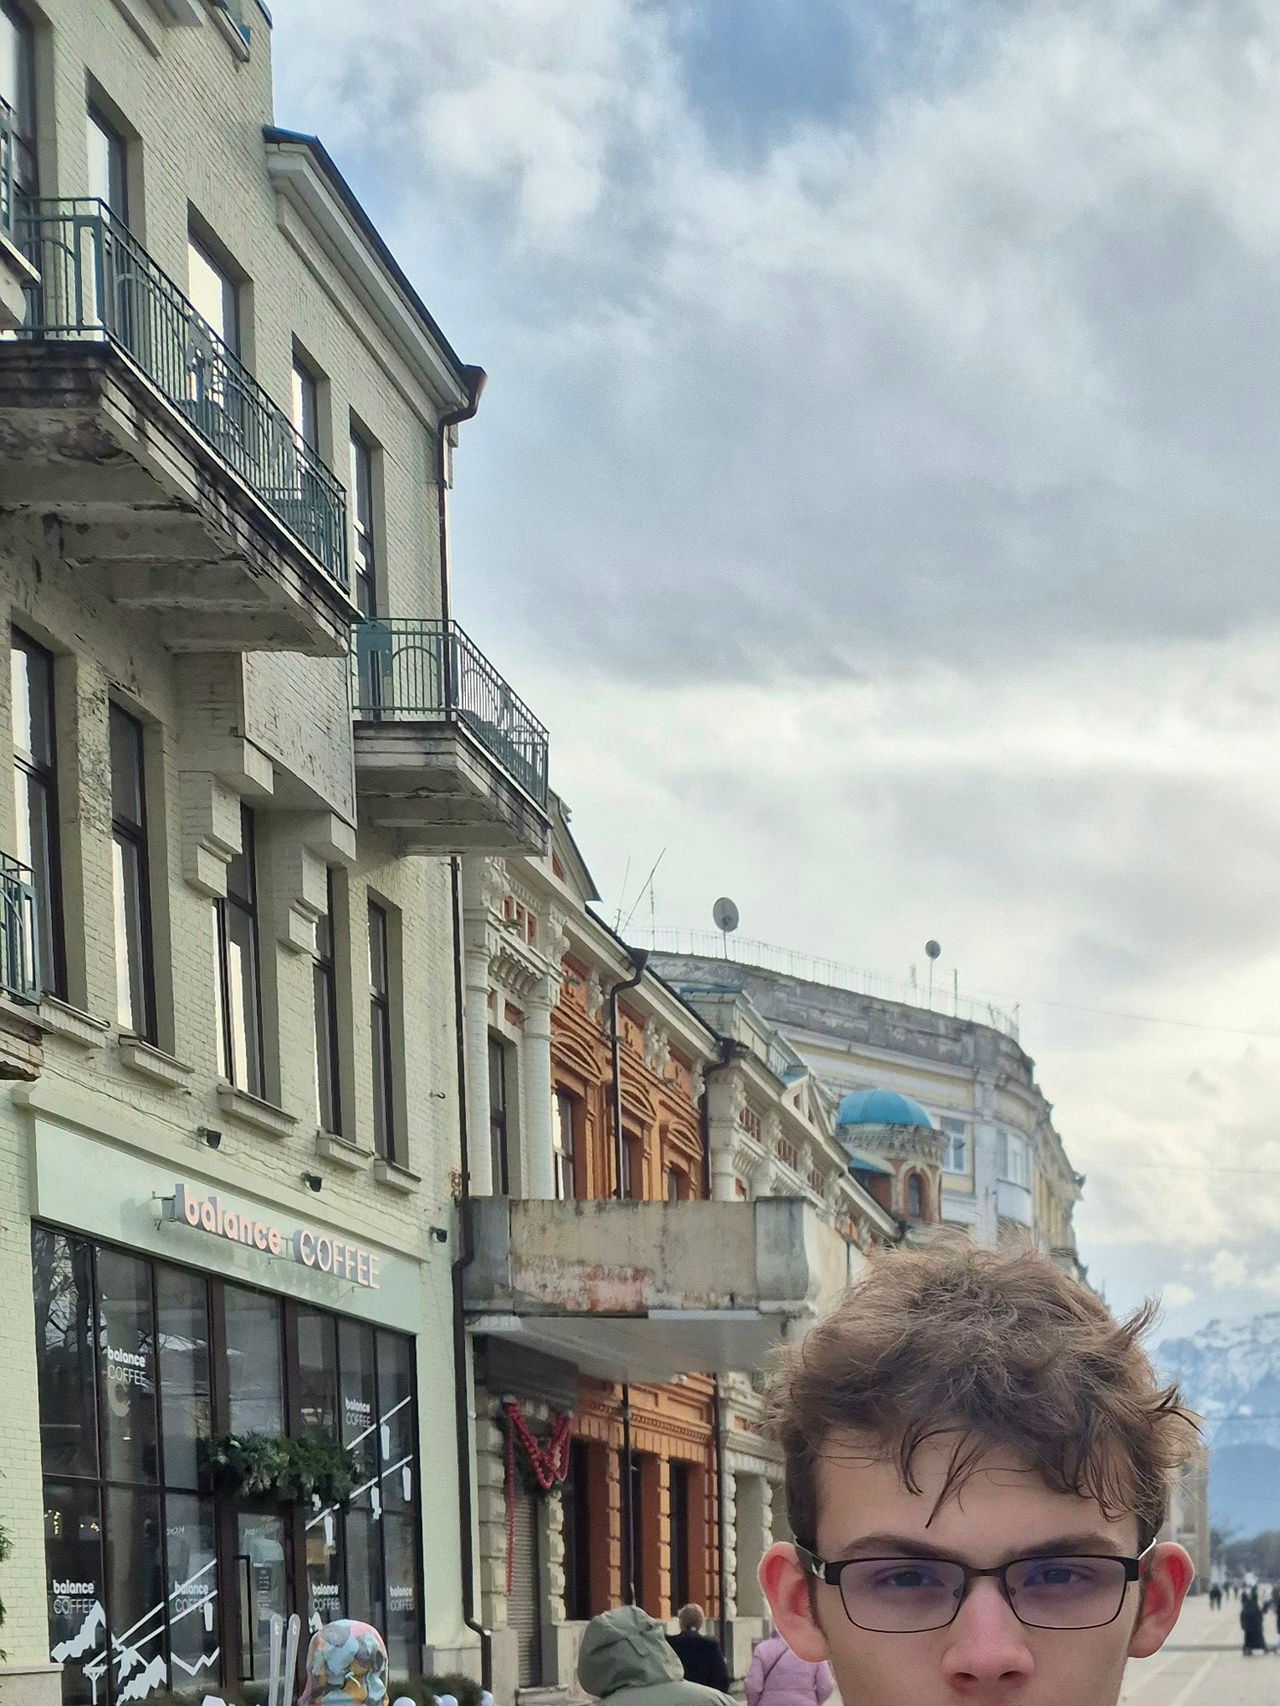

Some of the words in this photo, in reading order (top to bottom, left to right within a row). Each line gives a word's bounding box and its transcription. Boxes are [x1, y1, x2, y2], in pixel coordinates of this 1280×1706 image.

[176, 1183, 282, 1255] balance
[295, 1228, 381, 1289] COFFEE
[107, 1345, 146, 1367] balance
[107, 1365, 149, 1388] COFFEE
[53, 1579, 95, 1594] balance
